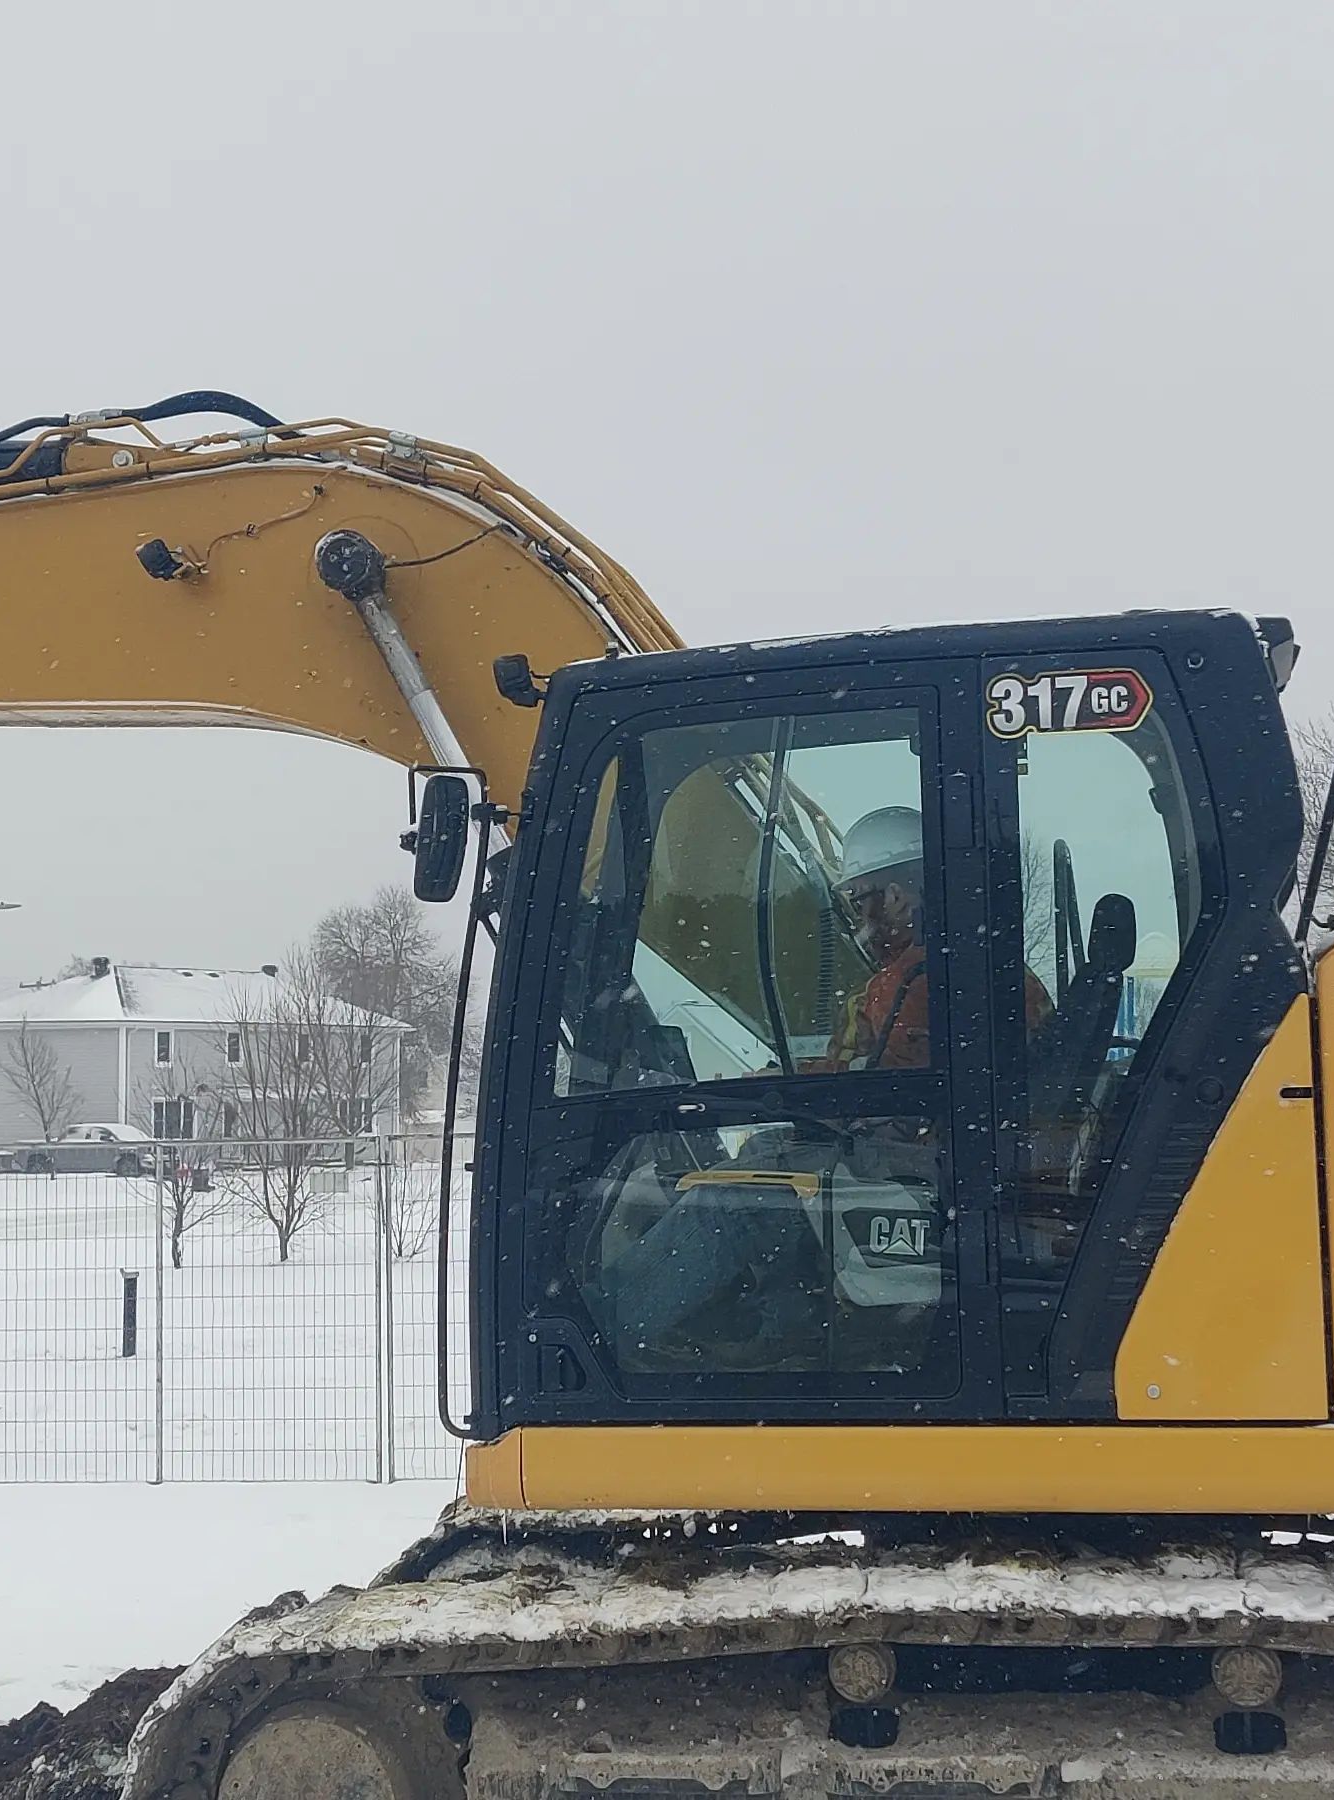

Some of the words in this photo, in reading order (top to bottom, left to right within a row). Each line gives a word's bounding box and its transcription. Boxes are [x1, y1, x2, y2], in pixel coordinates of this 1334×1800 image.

[991, 675, 1088, 732] 317
[1090, 685, 1129, 714] GC
[869, 1216, 931, 1256] CAT
